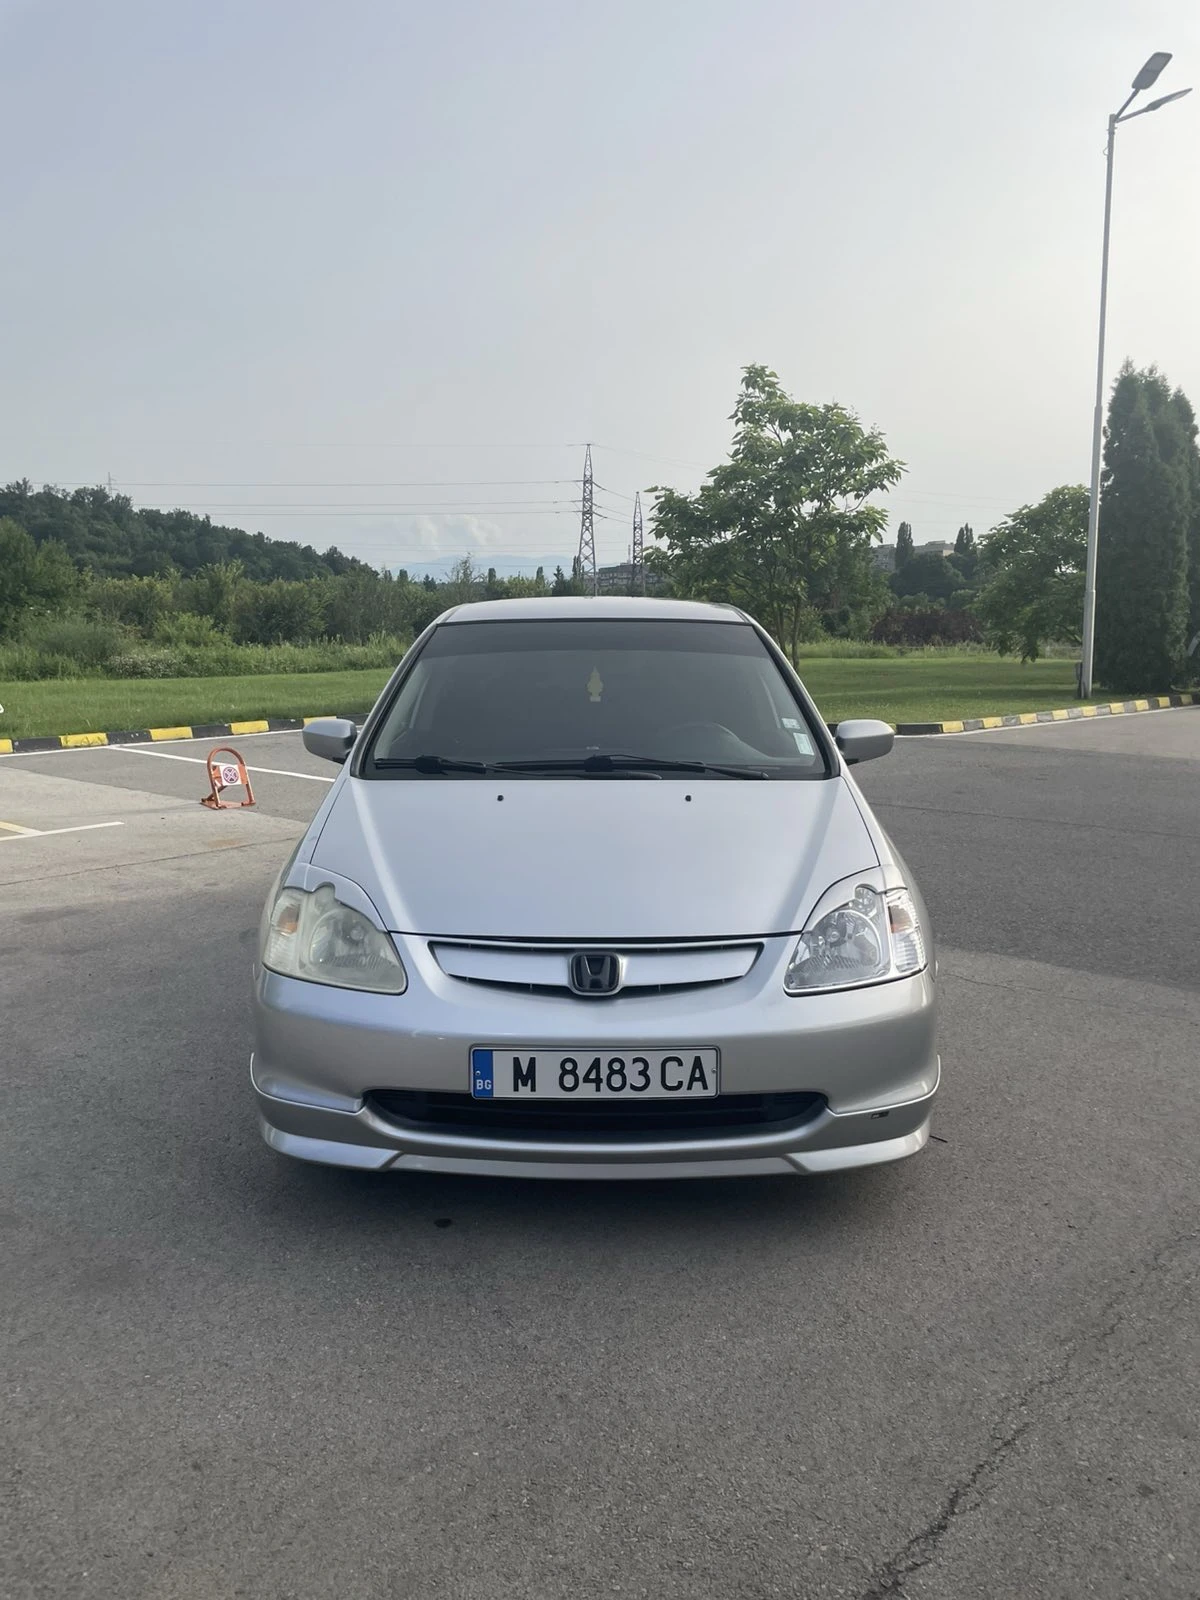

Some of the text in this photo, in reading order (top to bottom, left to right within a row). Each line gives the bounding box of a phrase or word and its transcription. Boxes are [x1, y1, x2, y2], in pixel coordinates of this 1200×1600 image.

[476, 1079, 492, 1090] BG
[513, 1055, 709, 1092] M 8483 CA
